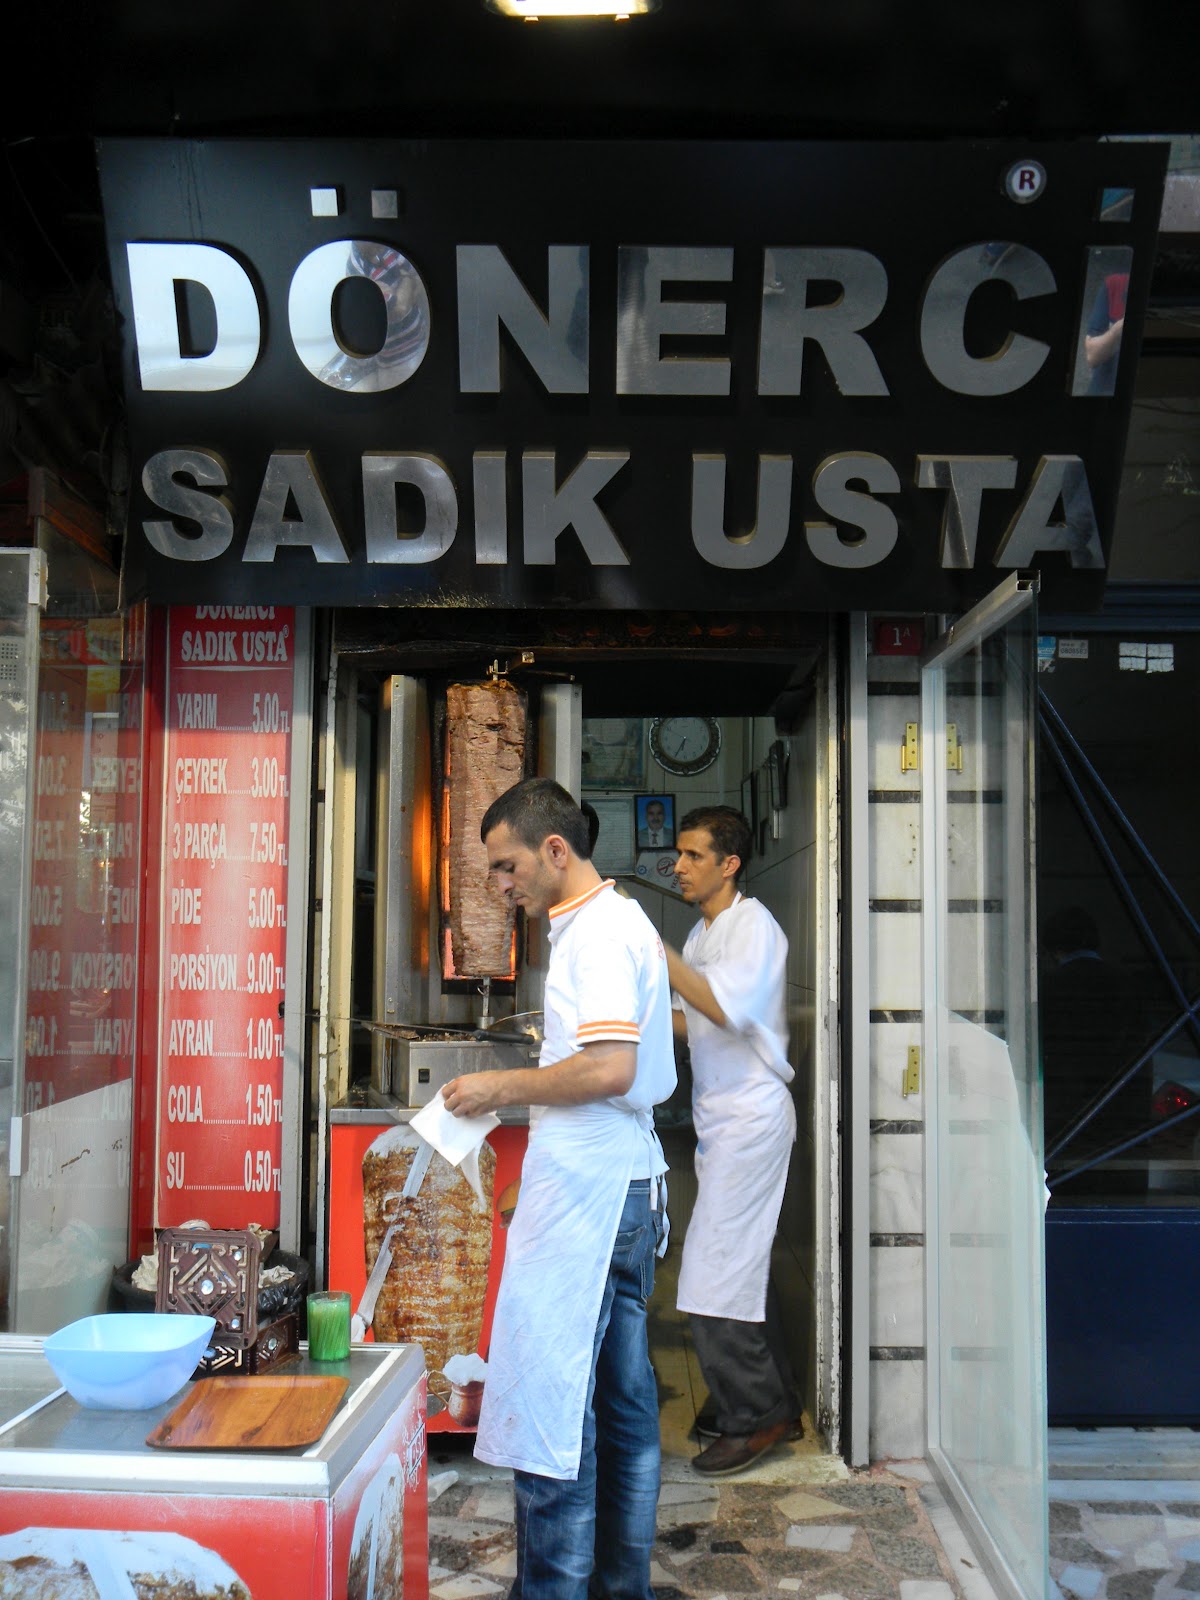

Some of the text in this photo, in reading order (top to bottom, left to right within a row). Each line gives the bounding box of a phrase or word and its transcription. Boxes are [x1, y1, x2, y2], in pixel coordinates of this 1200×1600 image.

[127, 187, 1135, 398] DÖNERCİ
[141, 446, 1106, 570] SADIK USTA
[181, 630, 238, 662] SADIK
[177, 693, 218, 729] YARIM
[252, 692, 279, 733] 5.00
[280, 711, 290, 733] TL
[175, 757, 289, 803] ÇEYREK 3.00 TL
[173, 823, 288, 869] 3 PARÇA 7.50 TL
[171, 879, 286, 928] PİDE 5.00 TL
[170, 945, 285, 994] PORSİYON 9.00 TL
[168, 1018, 284, 1060] AYRAN 1.00 TL
[168, 1085, 203, 1123] COLA
[245, 1084, 272, 1126] 1.50
[167, 1152, 185, 1189] SU
[244, 1150, 271, 1192] 0.50
